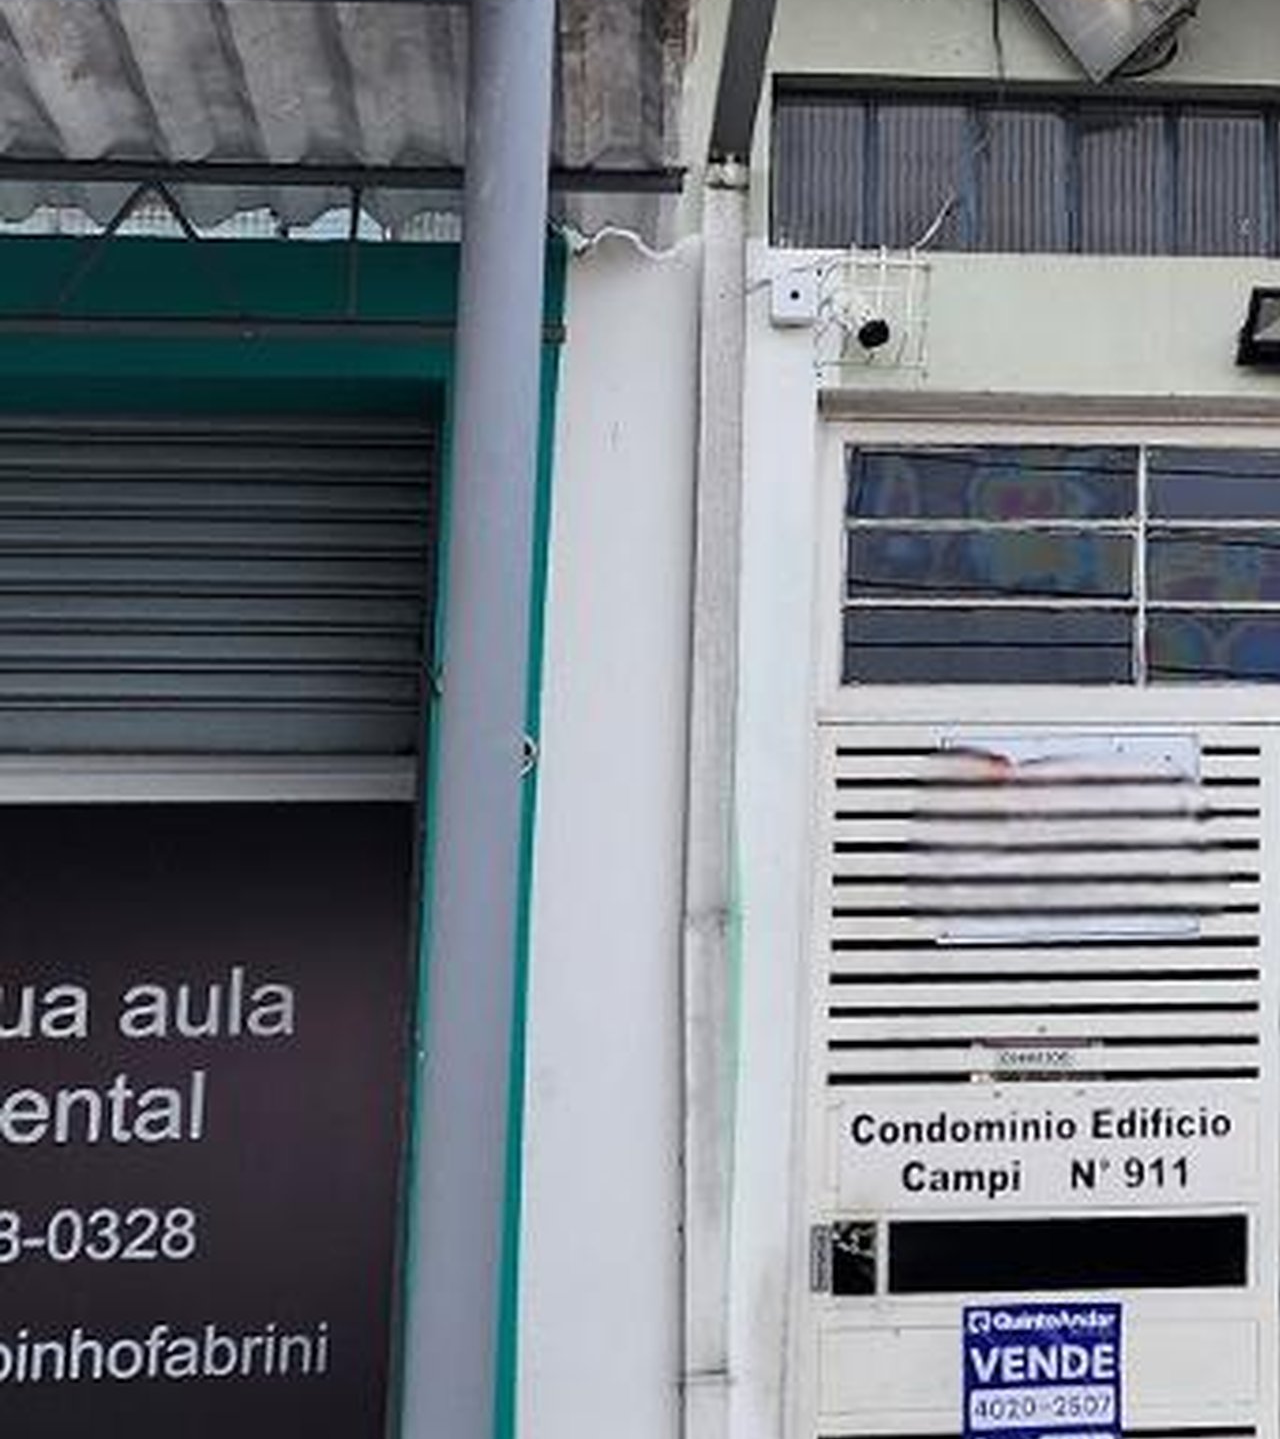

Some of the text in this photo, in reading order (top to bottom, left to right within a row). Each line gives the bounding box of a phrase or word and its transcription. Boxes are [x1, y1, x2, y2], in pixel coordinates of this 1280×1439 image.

[119, 967, 296, 1039] aula
[0, 1070, 206, 1144] ental
[851, 1107, 1232, 1146] Condominio Edificio
[901, 1160, 1021, 1198] Campi
[1125, 1156, 1190, 1189] 911
[970, 1344, 1115, 1383] VENDE
